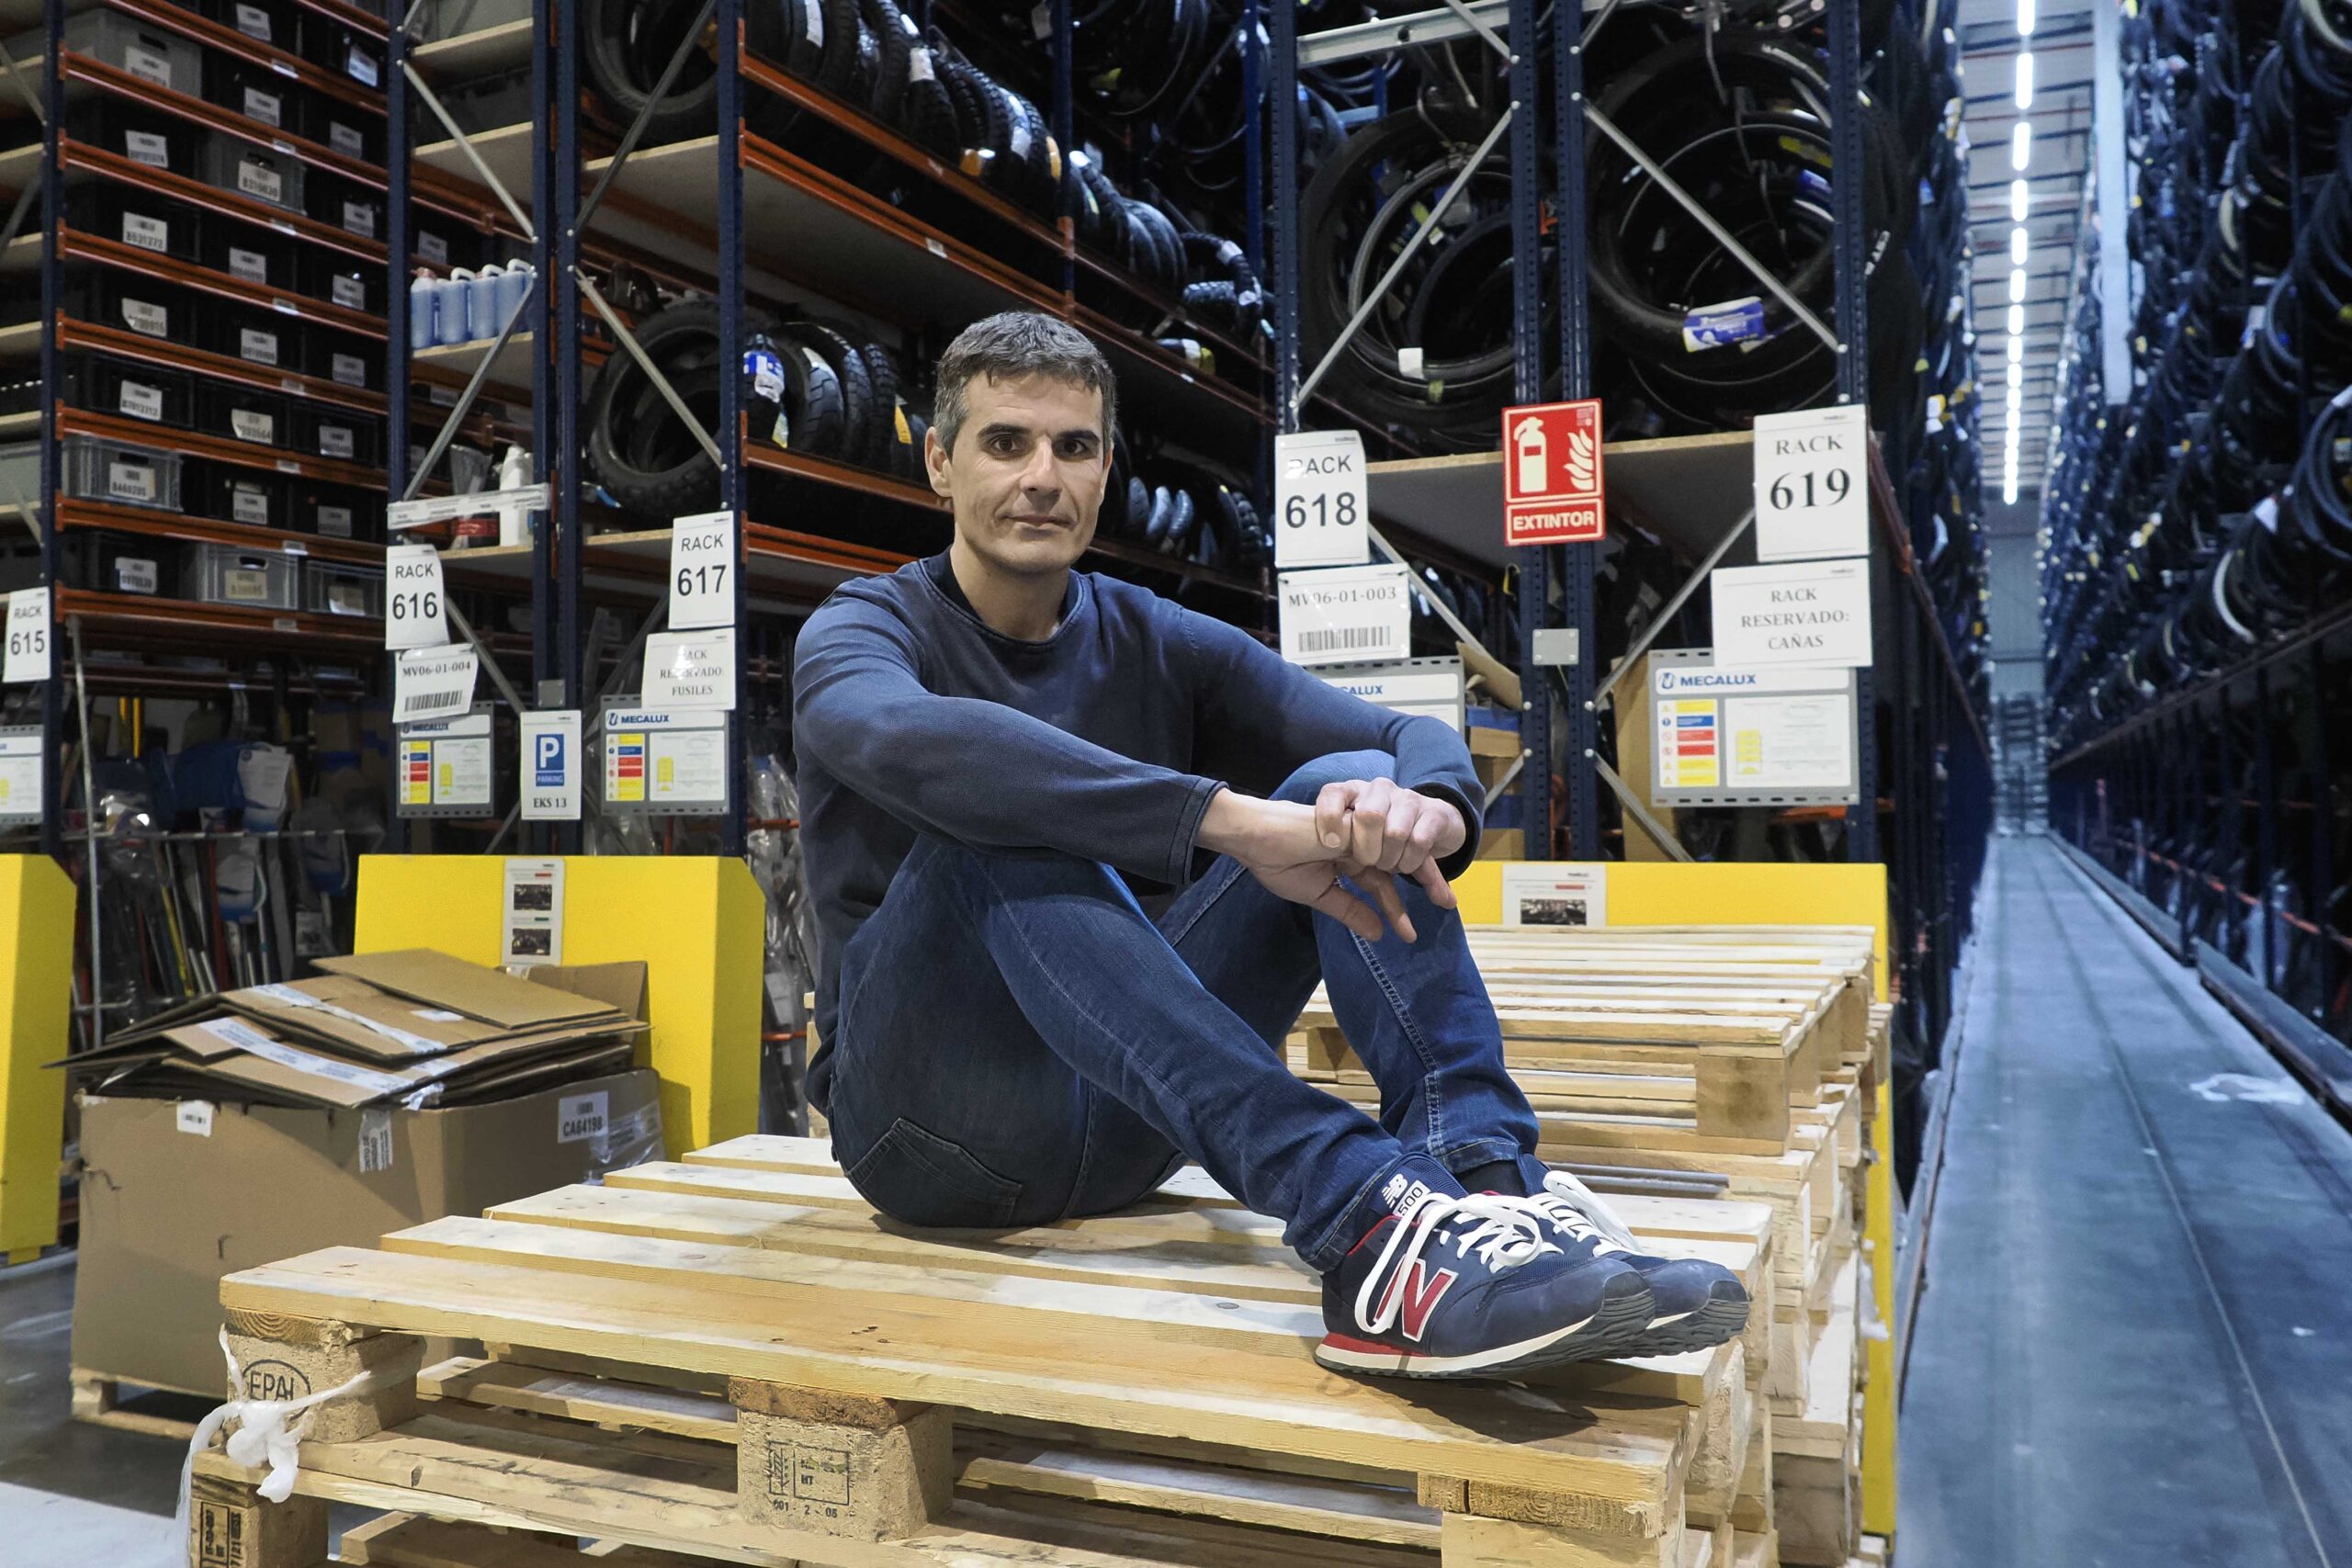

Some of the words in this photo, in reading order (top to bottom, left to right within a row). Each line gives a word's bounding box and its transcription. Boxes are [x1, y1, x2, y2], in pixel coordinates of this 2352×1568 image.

[1776, 435, 1843, 456] RACK
[1770, 468, 1850, 511] 619
[1285, 491, 1357, 529] 618
[1513, 510, 1596, 532] EXTINTOR
[681, 533, 724, 552] RACK
[395, 563, 435, 579] RACK
[677, 564, 727, 597] 617
[1770, 588, 1817, 604] RACK
[14, 605, 42, 620] RACK
[392, 592, 438, 621] 616
[1741, 609, 1850, 628] RESERVADO:
[10, 629, 45, 656] 615
[1768, 633, 1824, 650] CAÑAS
[402, 660, 471, 678] MV06-01-004
[1341, 684, 1383, 695] ALUX
[1679, 674, 1757, 687] MECALUX
[672, 685, 713, 696] FUSILES
[620, 714, 670, 724] MECALUX
[539, 737, 560, 768] P
[533, 796, 552, 808] EKS
[556, 796, 567, 808] 13
[1396, 1186, 1424, 1217] 500
[1373, 1253, 1459, 1343] N
